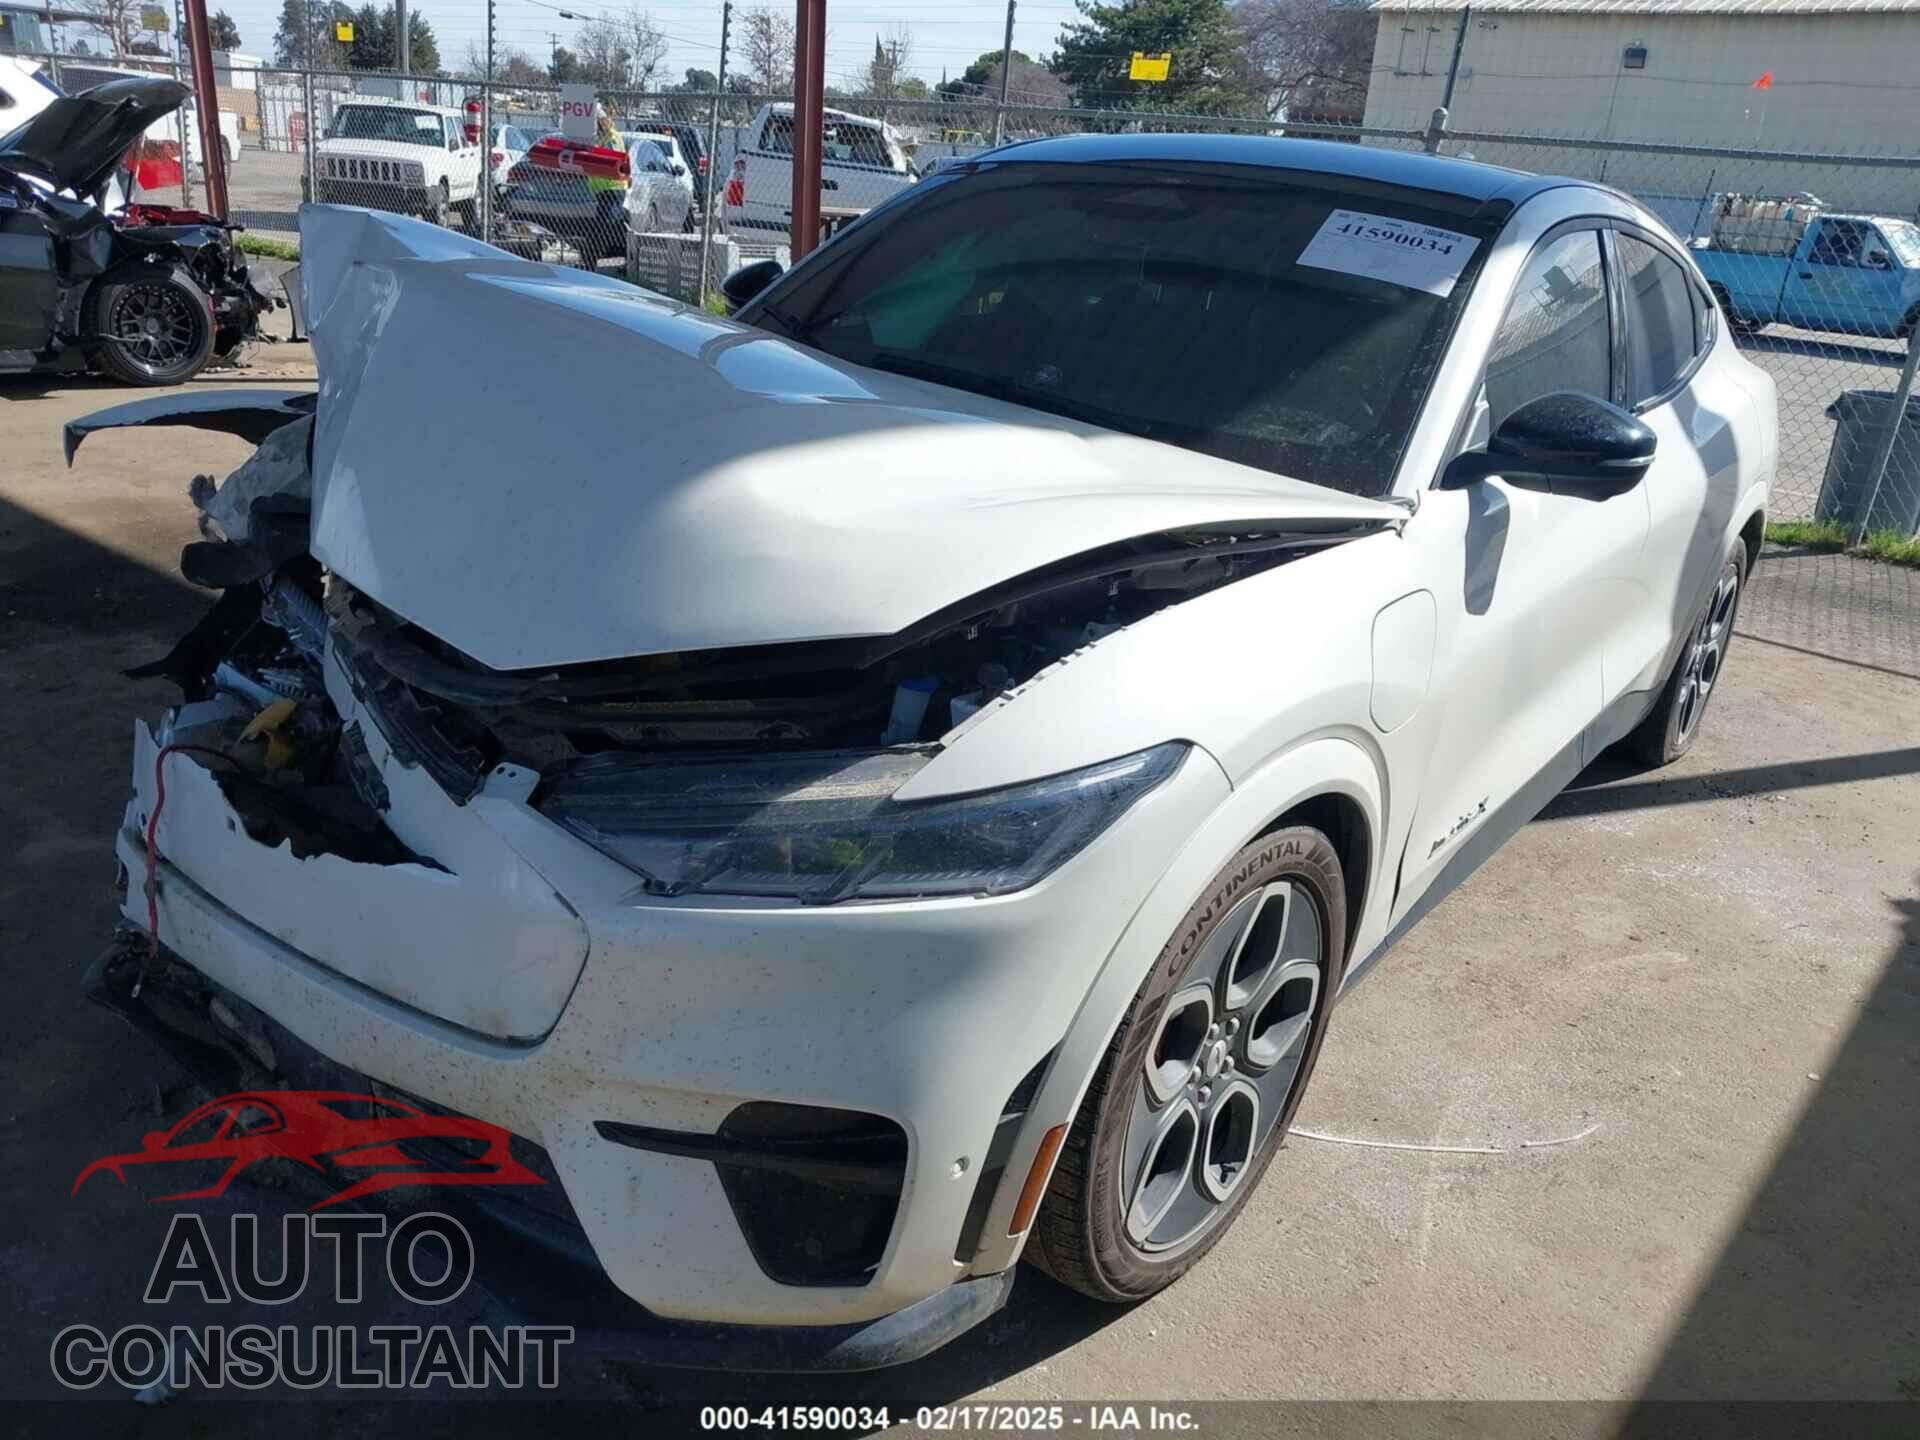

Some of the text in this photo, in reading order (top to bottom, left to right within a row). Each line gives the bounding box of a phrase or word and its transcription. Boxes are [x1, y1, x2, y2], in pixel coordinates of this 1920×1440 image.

[562, 101, 594, 117] PGV
[1336, 223, 1454, 256] 41590034
[1167, 839, 1304, 978] CONTINENTAL
